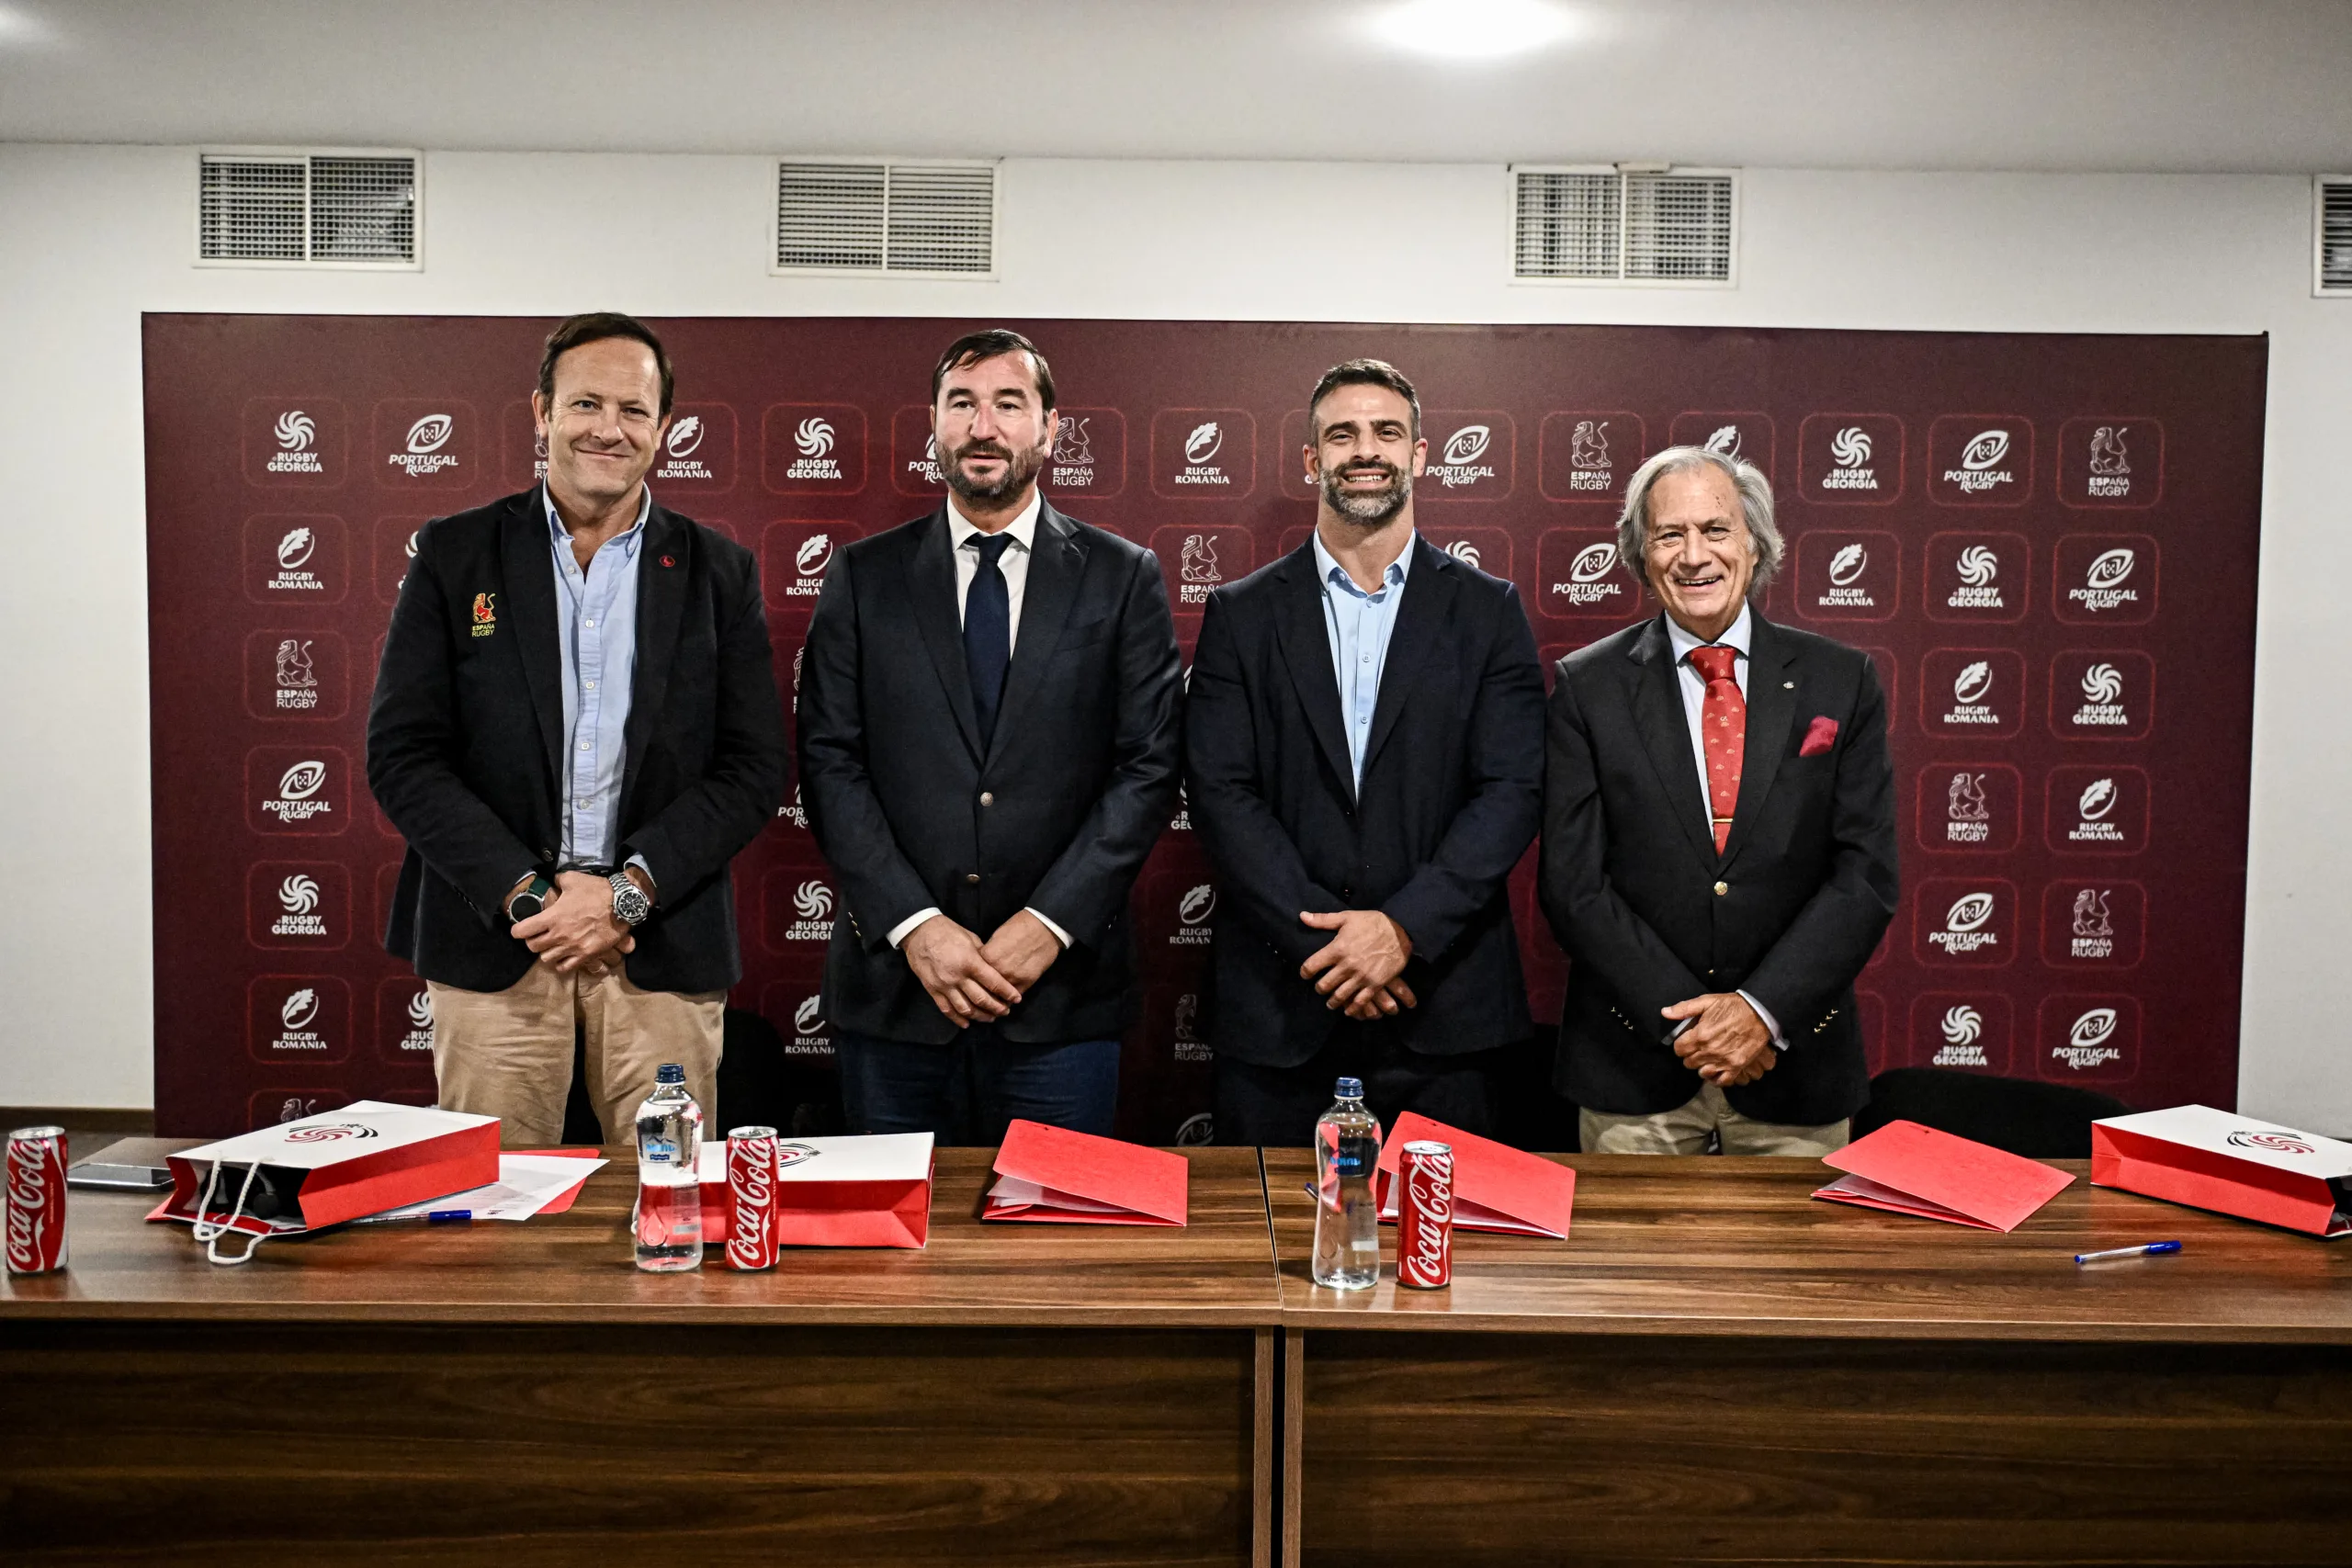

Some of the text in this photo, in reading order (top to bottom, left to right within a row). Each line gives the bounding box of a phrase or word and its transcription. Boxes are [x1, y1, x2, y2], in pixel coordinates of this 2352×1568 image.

[277, 453, 318, 462] RUGBY
[388, 455, 458, 466] PORTUGAL
[266, 461, 323, 472] GEORGIA
[667, 461, 703, 470] RUGBY
[797, 459, 838, 469] RUGBY
[908, 461, 940, 471] PORT
[405, 464, 439, 477] RUGBY
[657, 469, 713, 478] ROMANIA
[786, 468, 842, 479] GEORGIA
[1052, 466, 1093, 477] ESPAÑA
[1184, 468, 1220, 476] RUGBY
[1425, 467, 1494, 478] PORTUGAL
[1570, 469, 1611, 480] ESPAÑA
[1832, 469, 1873, 479] RUGBY
[1052, 476, 1093, 485] RUGBY
[1174, 475, 1230, 484] ROMANIA
[1943, 471, 2013, 482] PORTUGAL
[2087, 476, 2129, 487] ESPAÑA
[1442, 476, 1476, 488] RUGBY
[1570, 479, 1611, 490] RUGBY
[1822, 479, 1878, 489] GEORGIA
[1961, 480, 1995, 493] RUGBY
[2087, 486, 2129, 496] RUGBY
[277, 572, 313, 581] RUGBY
[267, 580, 324, 589] ROMANIA
[797, 579, 825, 587] RUG
[1181, 583, 1220, 593] ESPAÑ
[786, 587, 820, 595] ROMA
[1552, 583, 1621, 594] PORTUGAL
[1828, 589, 1864, 597] RUGBY
[1957, 588, 1998, 597] RUGBY
[1181, 593, 1207, 604] RUG
[1569, 592, 1603, 605] RUGBY
[1818, 596, 1874, 605] ROMANIA
[2068, 590, 2137, 601] PORTUGAL
[1947, 596, 2004, 607] GEORGIA
[2086, 599, 2120, 611] RUGBY
[472, 628, 495, 637] RUGBY
[276, 688, 317, 699] ESPAÑA
[276, 698, 317, 708] RUGBY
[1953, 706, 1989, 715] RUGBY
[2082, 705, 2123, 715] RUGBY
[1943, 714, 1999, 723] ROMANIA
[2072, 714, 2128, 725] GEORGIA
[262, 801, 331, 812] PORTUGAL
[279, 810, 313, 822] RUGBY
[1947, 821, 1988, 832] ESPAÑA
[2078, 823, 2114, 831] RUGBY
[1947, 831, 1988, 841] RUGBY
[2068, 830, 2124, 840] ROMANIA
[281, 916, 322, 925] RUGBY
[271, 924, 327, 934] GEORGIA
[796, 921, 835, 931] RUGBY
[786, 931, 831, 940] GEORGI
[1170, 936, 1211, 944] ROMAN
[1928, 932, 1996, 943] PORTUGAL
[2071, 937, 2112, 948] ESPAÑA
[1946, 942, 1980, 954] RUGBY
[2071, 947, 2112, 956] RUGBY
[282, 1032, 318, 1041] RUGBY
[411, 1031, 434, 1040] RUG
[272, 1040, 327, 1049] ROMANIA
[401, 1040, 434, 1050] GEOR
[795, 1037, 831, 1045] RUGBY
[1942, 1046, 1984, 1055] RUGBY
[2052, 1047, 2120, 1058] PORTUGAL
[1174, 1051, 1214, 1061] RUGBY
[1932, 1055, 1988, 1066] GEORGIA
[2069, 1056, 2103, 1069] RUGBY
[6, 1140, 46, 1273] Coca-Cola
[728, 1138, 771, 1269] Coca-Cola
[1407, 1154, 1452, 1287] Coca-Cola
